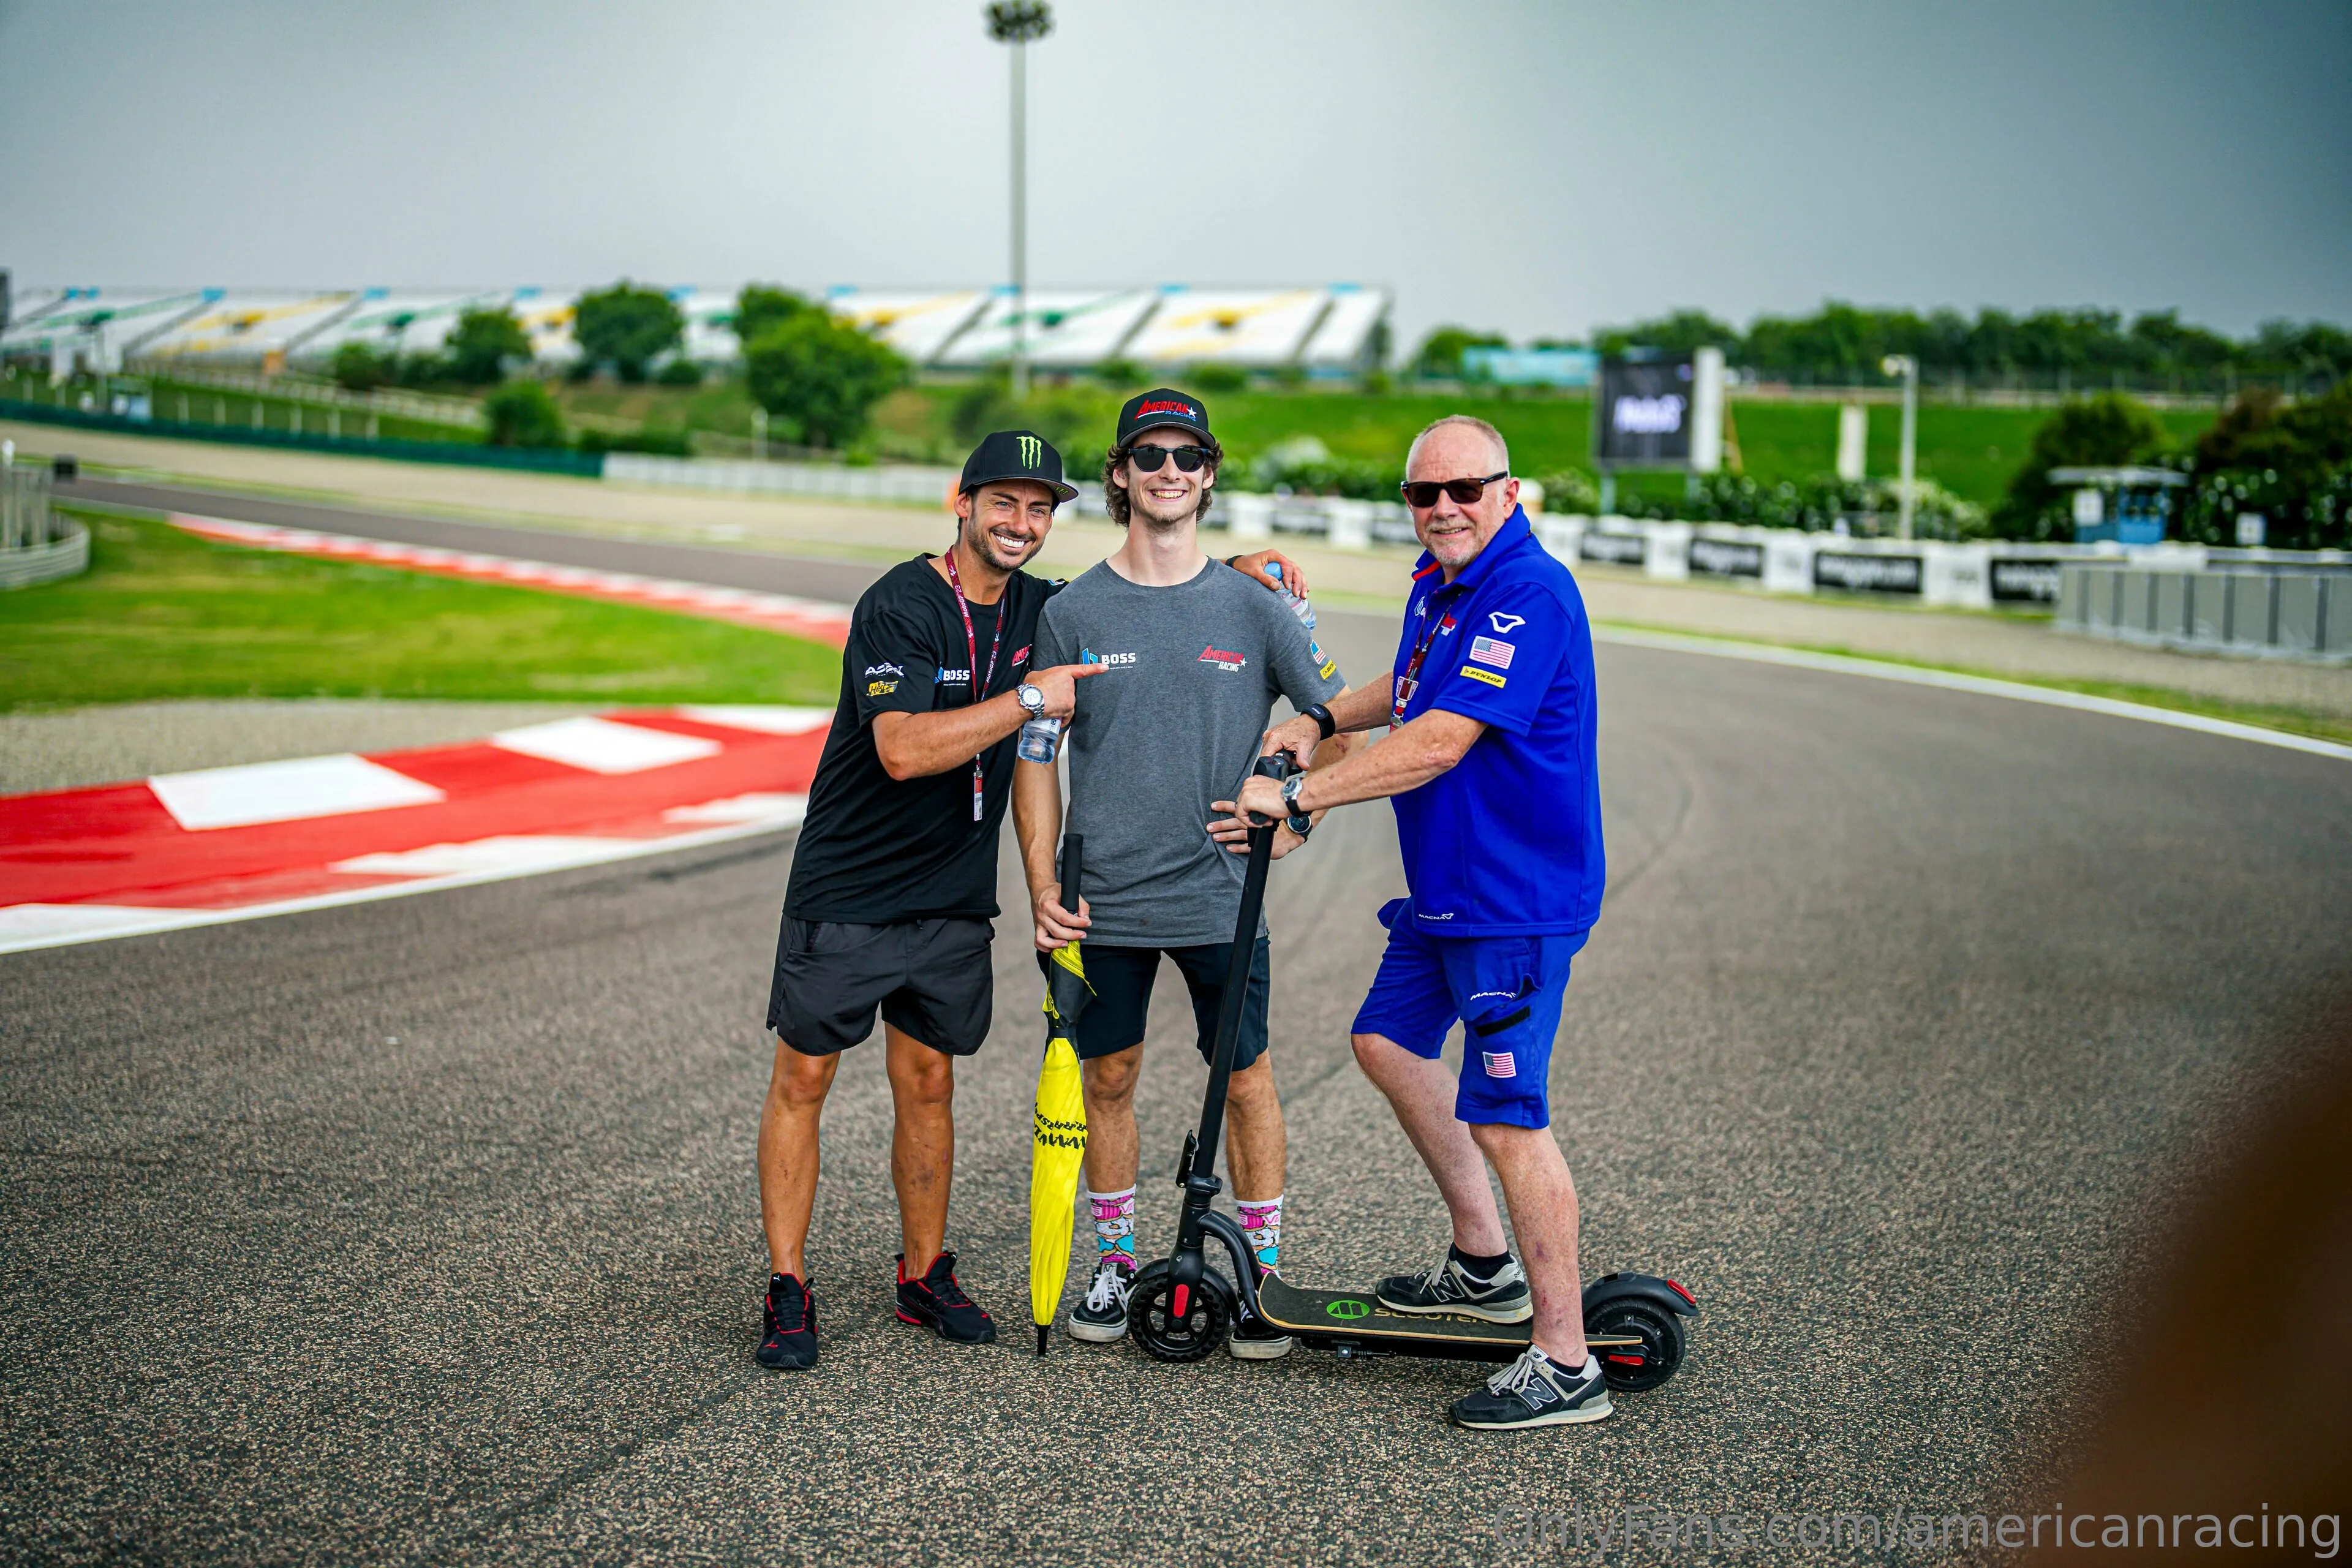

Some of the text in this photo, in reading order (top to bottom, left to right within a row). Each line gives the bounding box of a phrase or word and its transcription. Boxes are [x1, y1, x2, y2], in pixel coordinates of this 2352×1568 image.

[1133, 399, 1190, 421] AMERICAN
[1165, 410, 1197, 422] RACING
[1101, 652, 1137, 665] BOSS
[1197, 644, 1245, 665] AMERICAN
[1218, 661, 1240, 673] RACING
[943, 669, 970, 681] BOSS
[1470, 671, 1502, 684] DUNLOP
